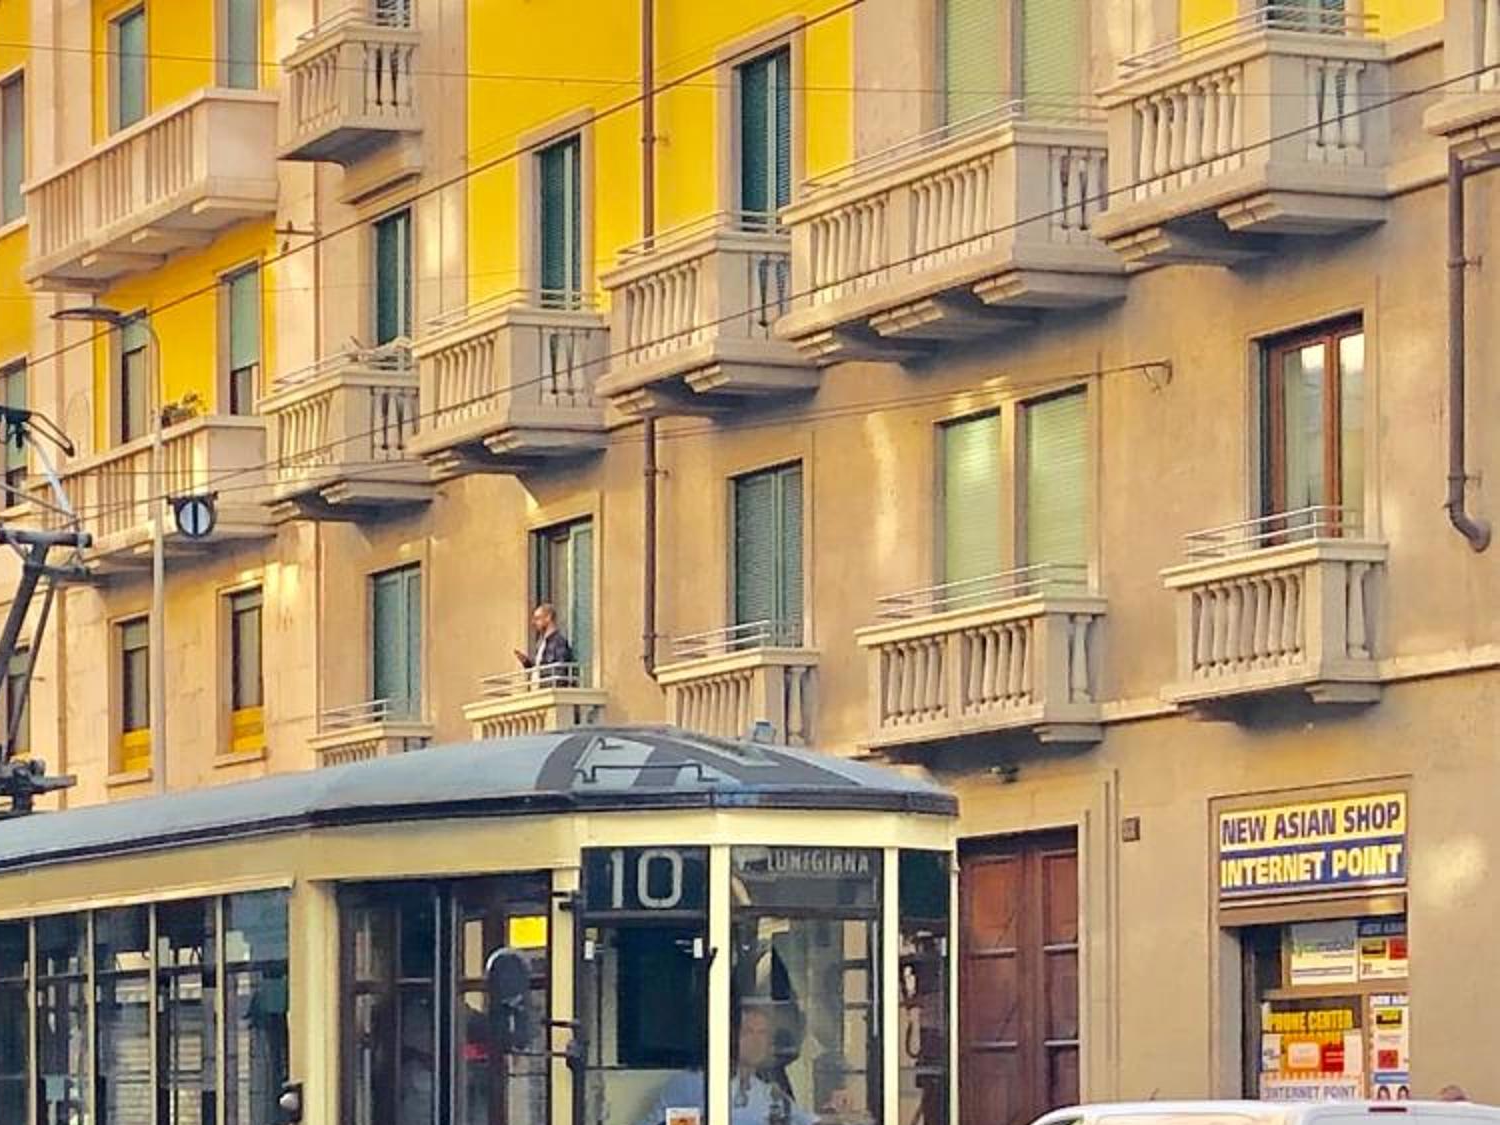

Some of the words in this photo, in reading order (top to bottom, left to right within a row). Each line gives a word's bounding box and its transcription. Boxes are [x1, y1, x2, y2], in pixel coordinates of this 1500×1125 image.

[1222, 816, 1267, 845] NEW
[1274, 807, 1337, 840] ASIAN
[1344, 801, 1401, 833] SHOP
[611, 848, 683, 909] 10
[766, 848, 869, 873] LUNIGIANA
[1221, 850, 1326, 888] INTERNET
[1332, 844, 1403, 879] POINT
